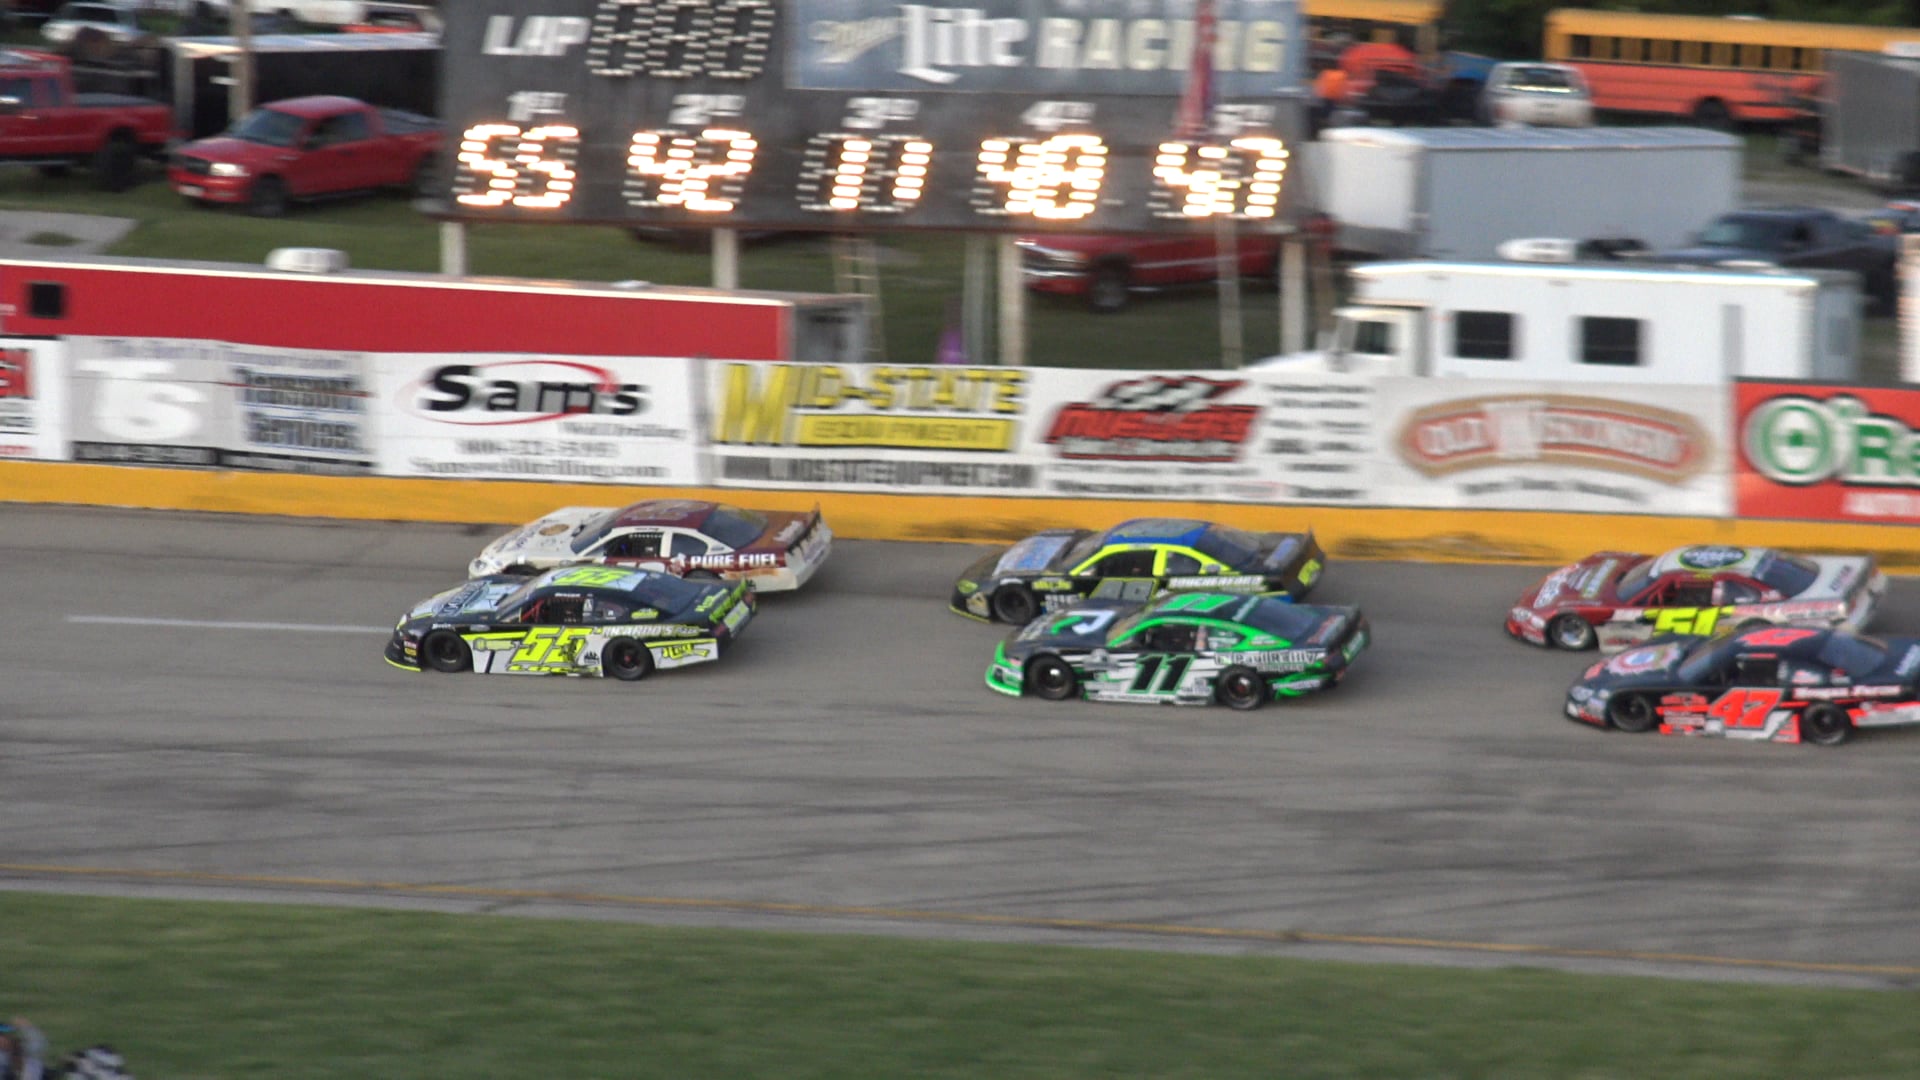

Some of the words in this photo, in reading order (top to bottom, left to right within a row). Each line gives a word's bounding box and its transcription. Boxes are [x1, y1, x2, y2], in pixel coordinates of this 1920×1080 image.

[482, 14, 591, 56] LAP
[896, 3, 1030, 84] Lite
[456, 123, 579, 208] 55
[829, 138, 933, 210] 11
[690, 554, 735, 568] PURE
[738, 553, 778, 567] FUEL
[1653, 605, 1721, 637] 51
[1128, 653, 1196, 695] 11
[1706, 686, 1783, 730] 47
